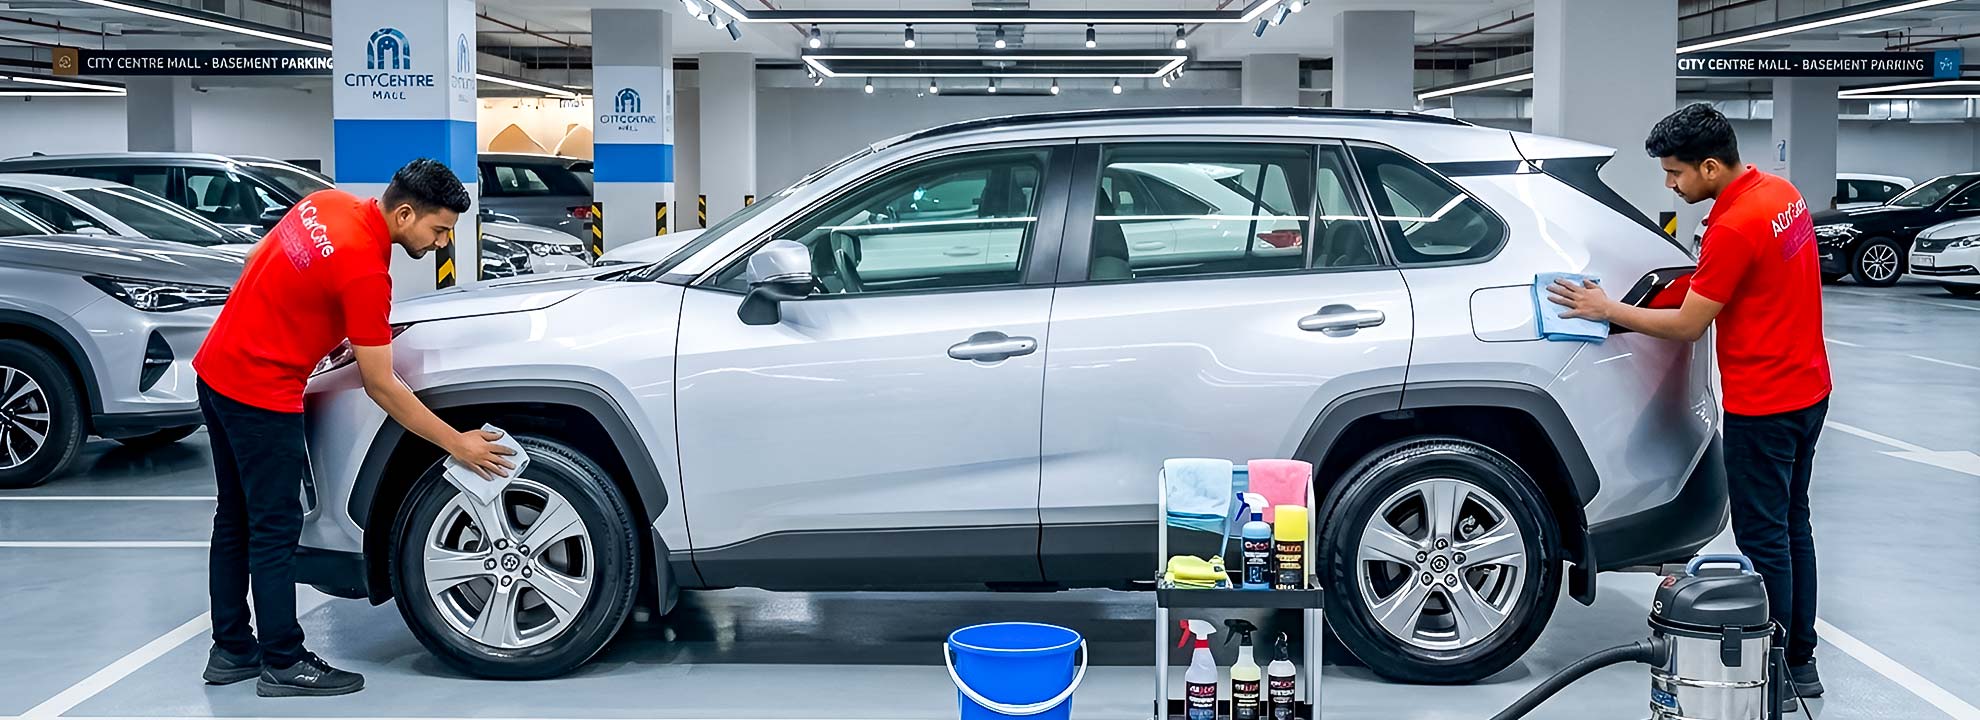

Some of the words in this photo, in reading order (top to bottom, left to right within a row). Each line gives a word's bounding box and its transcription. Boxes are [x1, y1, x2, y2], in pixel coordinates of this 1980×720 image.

[87, 57, 114, 69] CITY
[117, 57, 164, 69] CENTRE
[167, 57, 201, 69] MALL
[212, 57, 279, 69] BASEMENT
[281, 57, 333, 69] PARKING
[1677, 58, 1706, 71] CITY
[1708, 58, 1755, 70] CENTRE
[1758, 59, 1792, 70] MALL
[1802, 59, 1868, 70] BASEMENT
[1871, 59, 1924, 71] PARKING
